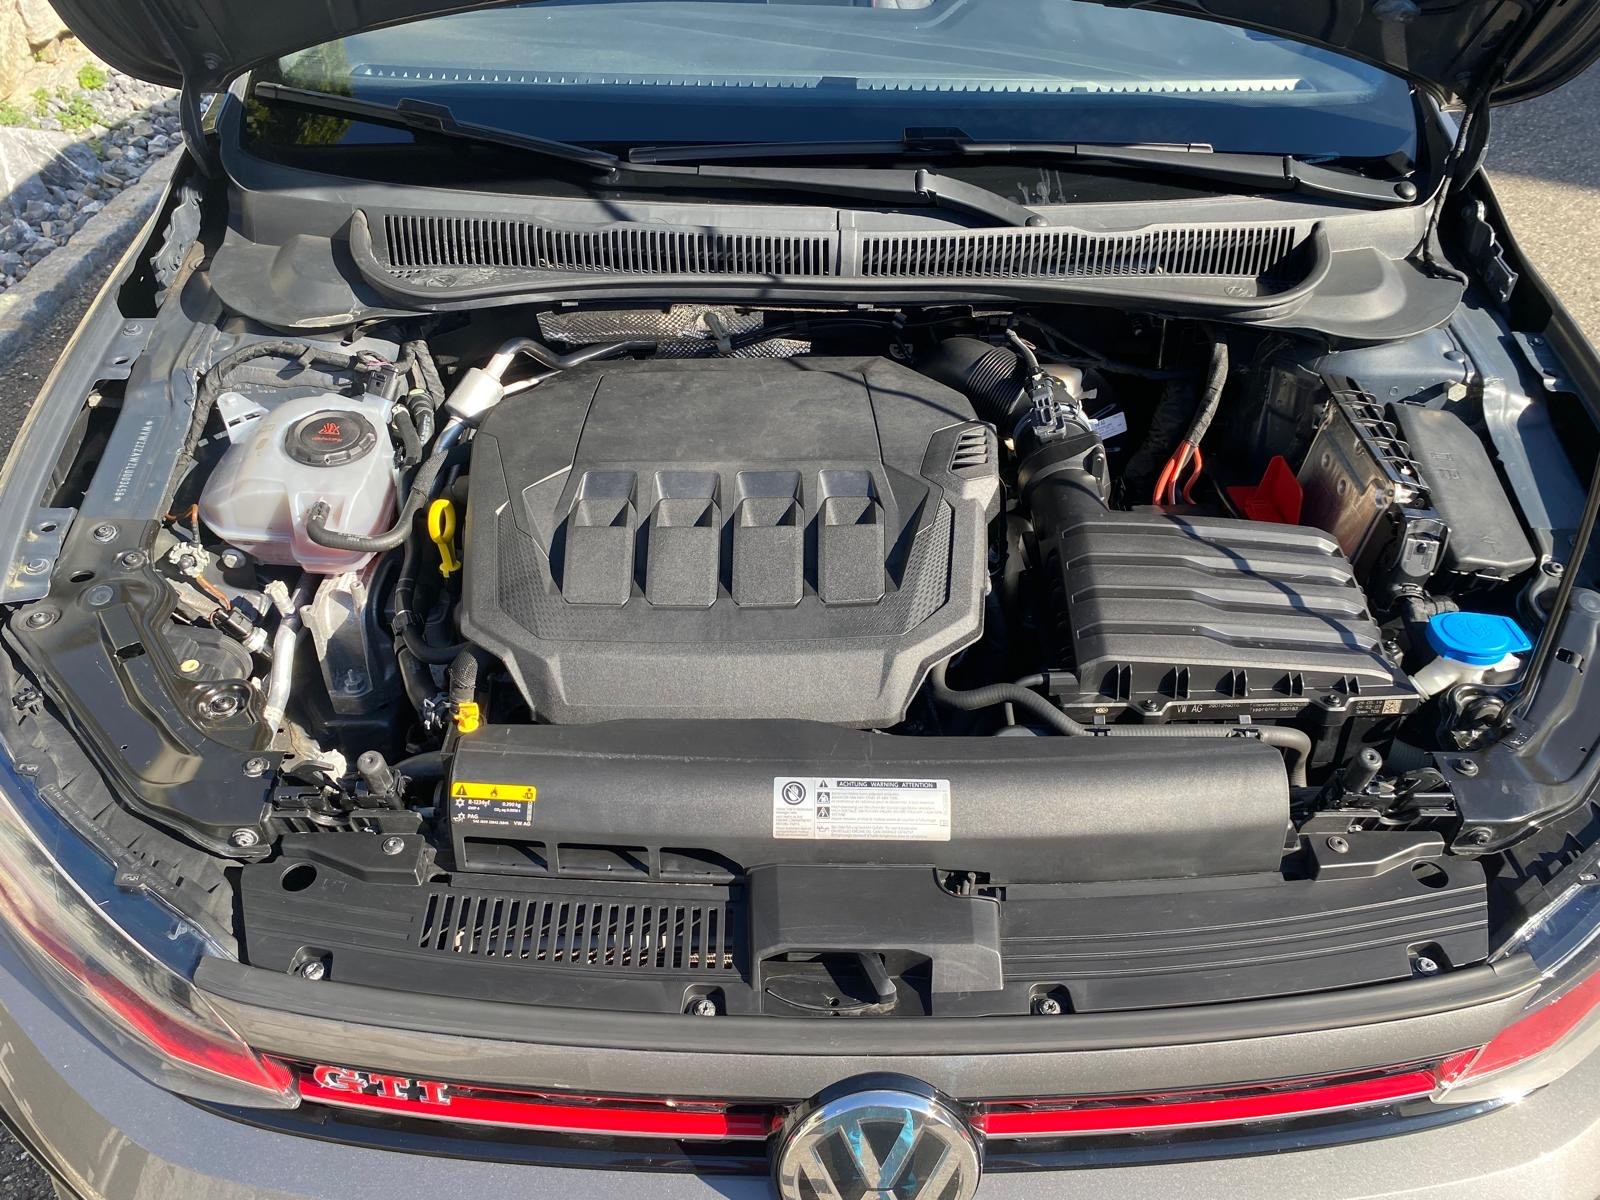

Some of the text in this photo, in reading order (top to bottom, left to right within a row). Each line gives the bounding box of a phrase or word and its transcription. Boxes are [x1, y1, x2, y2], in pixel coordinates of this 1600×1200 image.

[1177, 705, 1188, 713] VW
[1191, 704, 1203, 713] AG
[468, 800, 490, 808] R-1234yf
[313, 1064, 452, 1106] GTI
